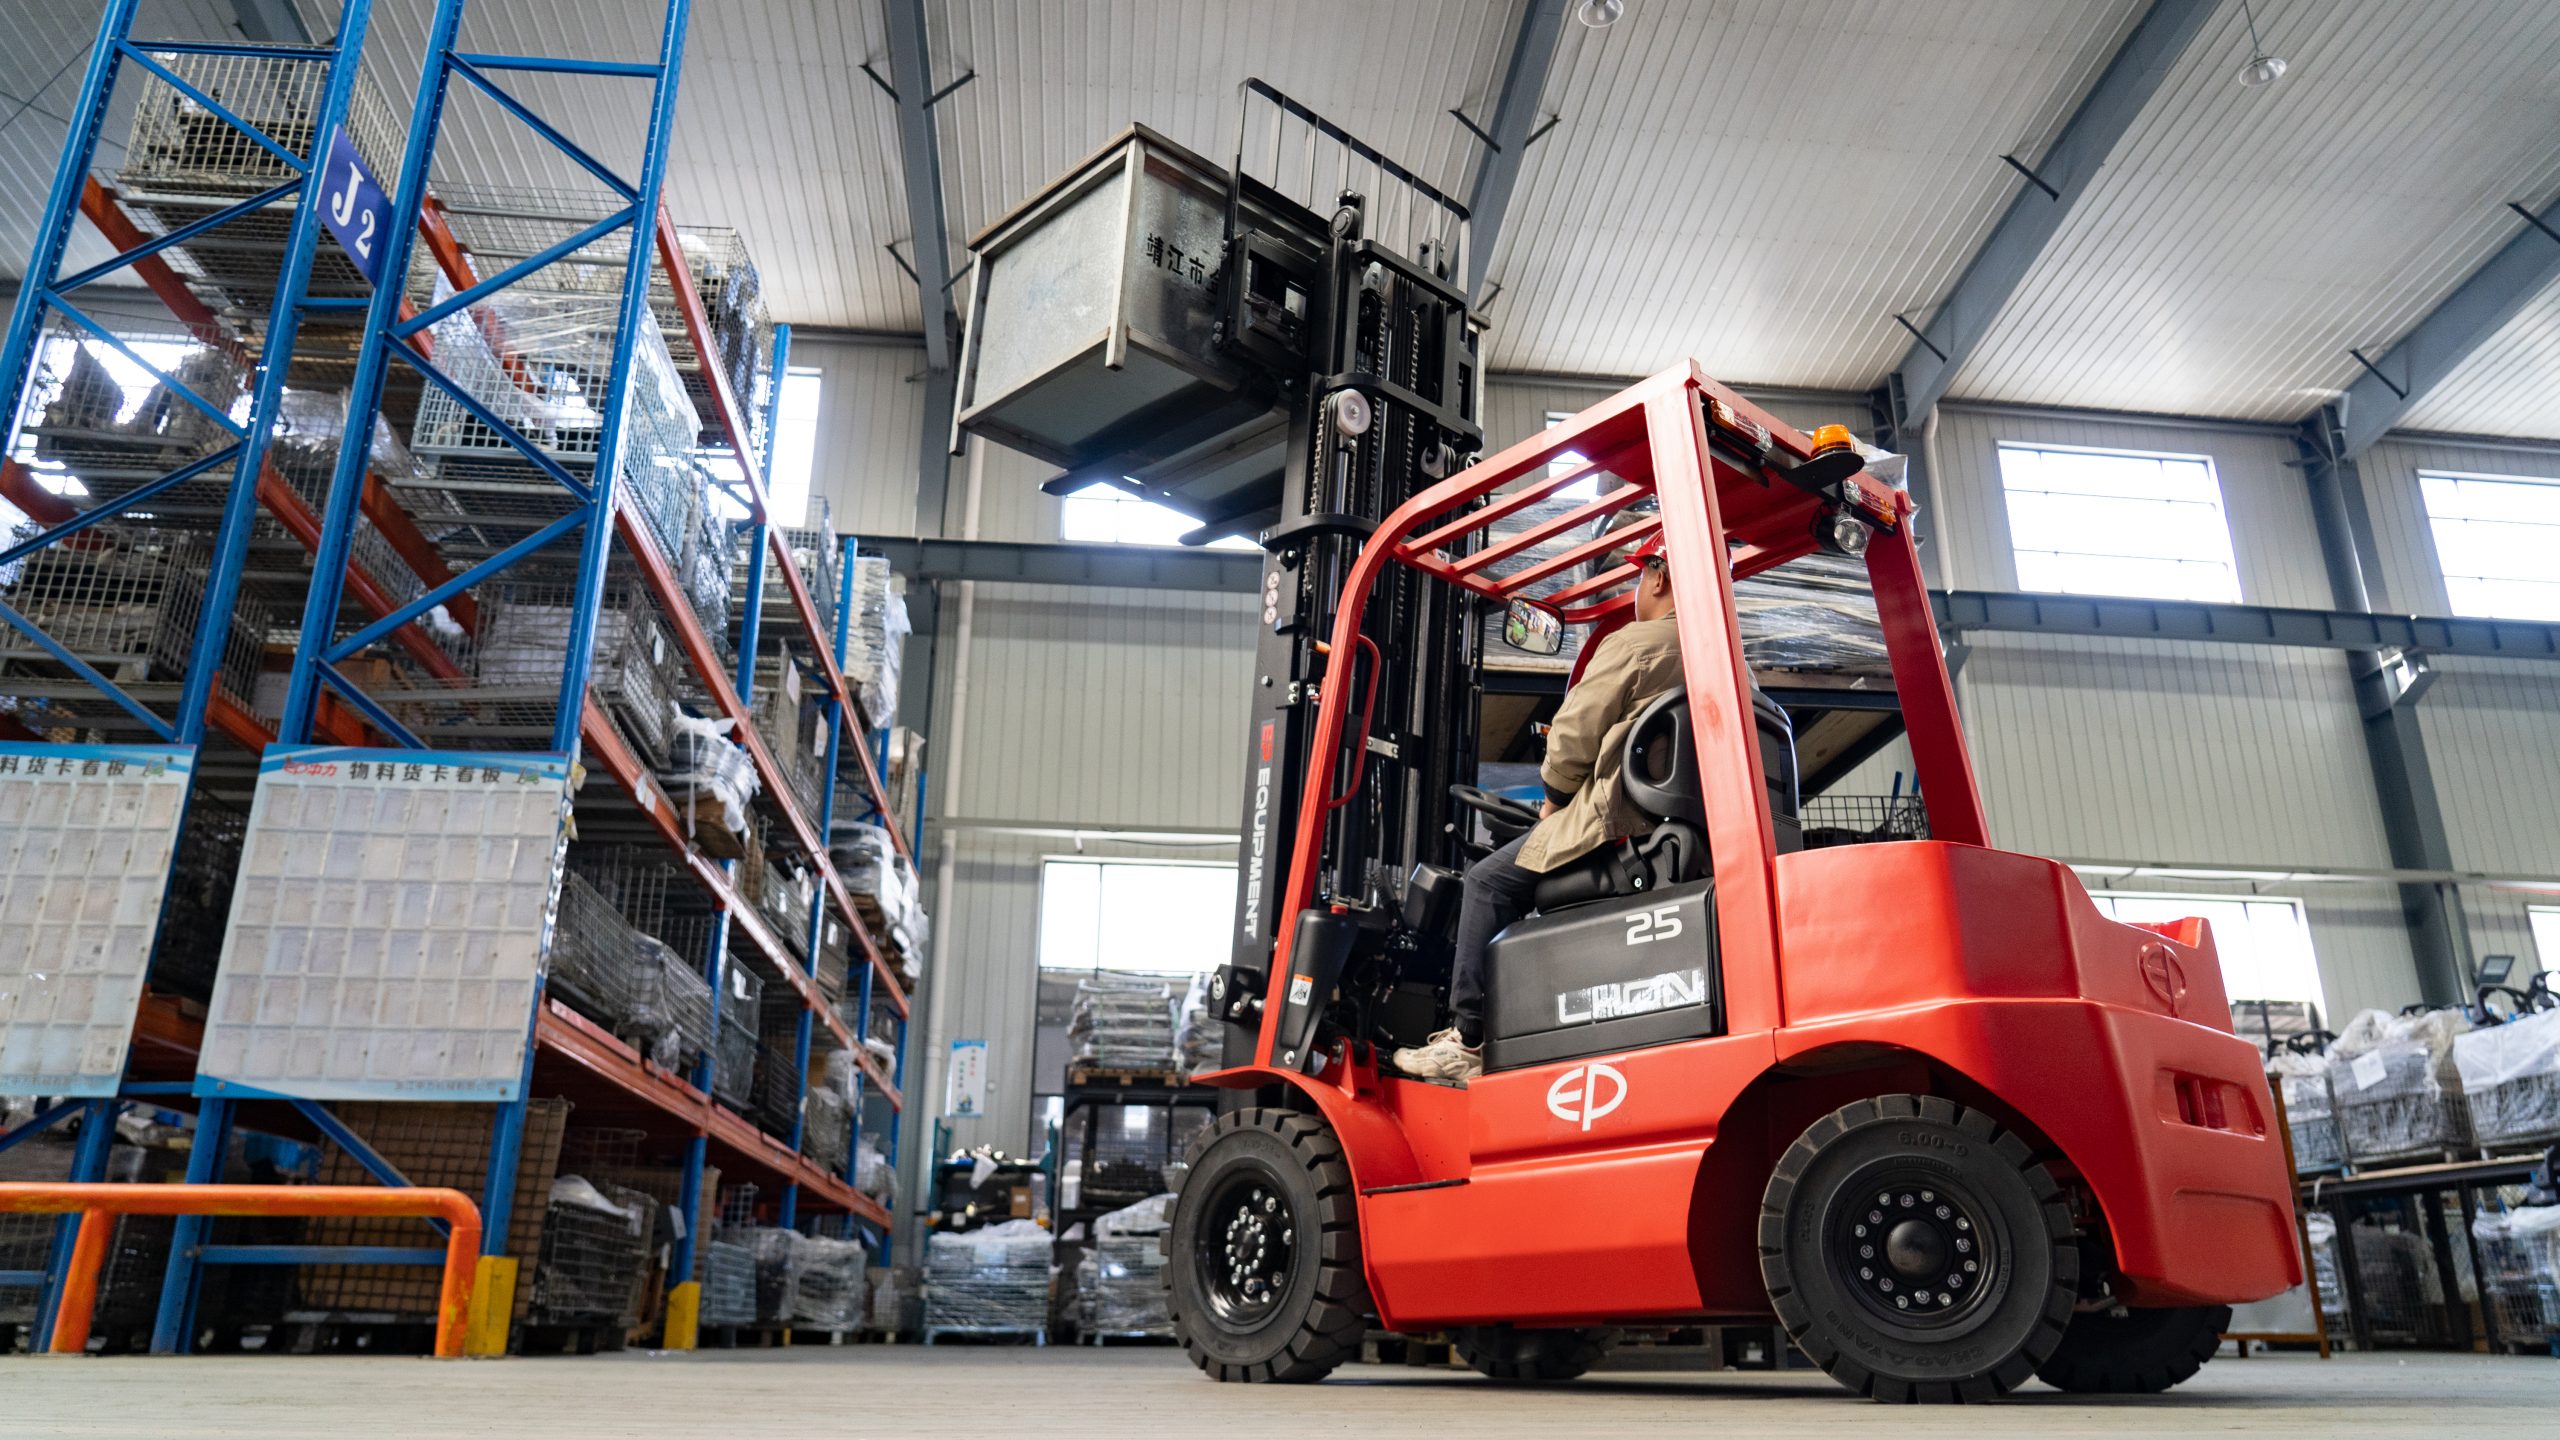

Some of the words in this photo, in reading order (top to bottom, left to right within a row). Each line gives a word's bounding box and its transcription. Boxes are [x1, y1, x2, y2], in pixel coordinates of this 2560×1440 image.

[1261, 723, 1275, 762] EP
[349, 761, 502, 784] 物料货卡看板
[1244, 767, 1271, 939] EQUIPMENT
[1626, 905, 1683, 946] 25
[1547, 1064, 1628, 1132] EP
